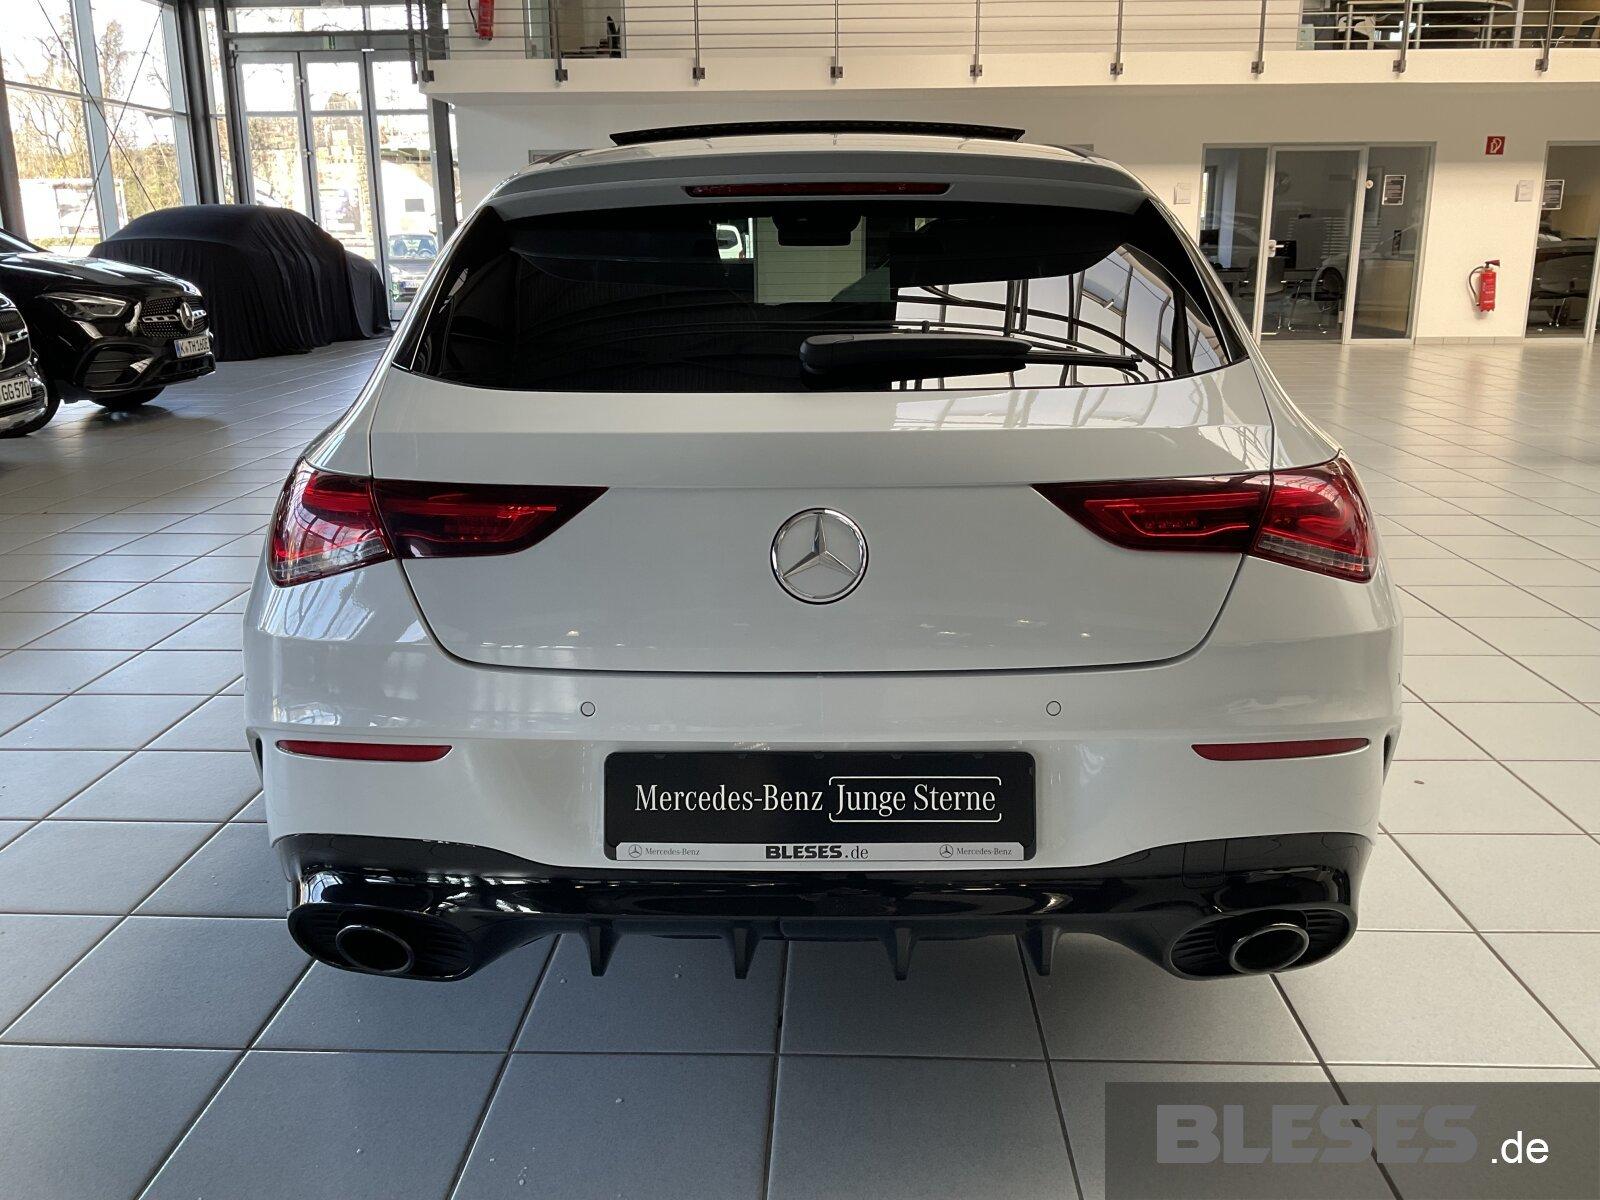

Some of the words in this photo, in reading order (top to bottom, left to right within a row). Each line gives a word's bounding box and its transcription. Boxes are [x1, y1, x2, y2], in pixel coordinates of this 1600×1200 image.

[634, 783, 823, 812] Mercedes-Benz
[836, 783, 906, 818] Junge
[913, 783, 996, 812] Sterne
[645, 847, 700, 857] Mercedes-Benz
[765, 845, 869, 860] BLESES.de
[957, 846, 1012, 857] Mercedes-Benz
